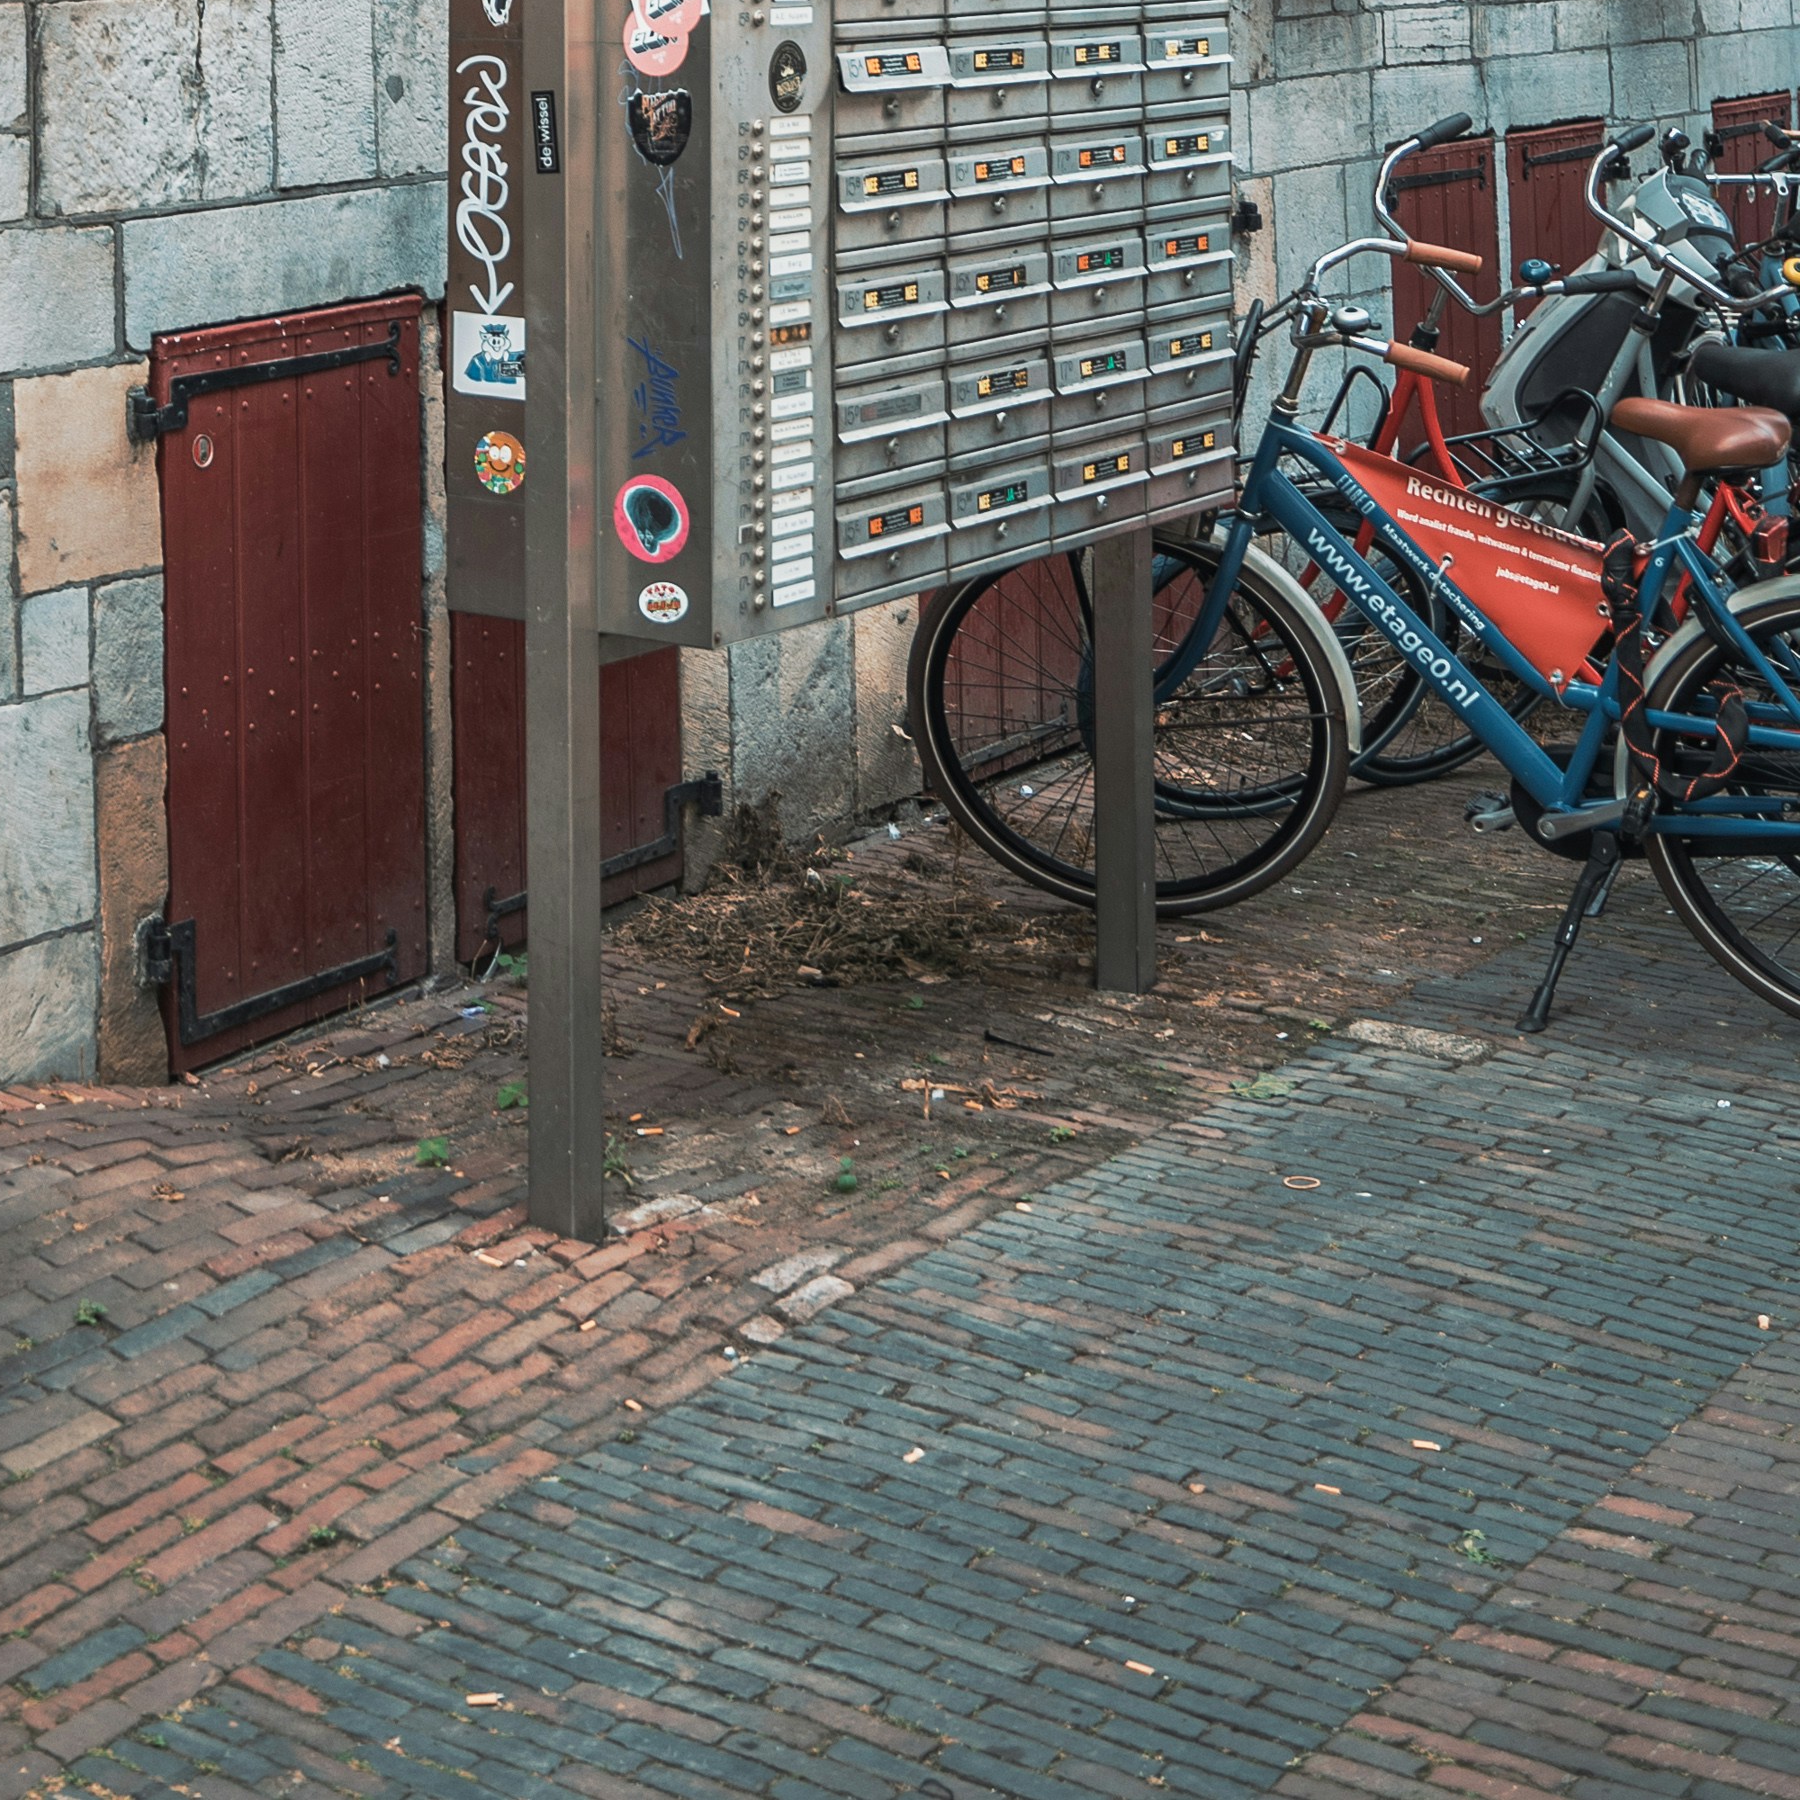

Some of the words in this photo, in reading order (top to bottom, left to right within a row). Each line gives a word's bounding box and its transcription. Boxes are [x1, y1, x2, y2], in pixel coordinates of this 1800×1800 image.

[536, 97, 550, 142] wissel
[540, 145, 552, 168] de
[1406, 476, 1492, 519] Rechten
[1397, 508, 1419, 524] Word
[1419, 515, 1447, 532] analist
[1447, 522, 1476, 542] fraude,
[1477, 535, 1521, 555] witwassen
[1520, 547, 1528, 558] &
[1529, 549, 1570, 571] terrorisme
[1382, 523, 1429, 574] Maatwerk
[1428, 568, 1486, 631] dtachering
[1496, 566, 1560, 595] jobs@etage0.nl
[1307, 527, 1481, 709] www.etage0.nl
